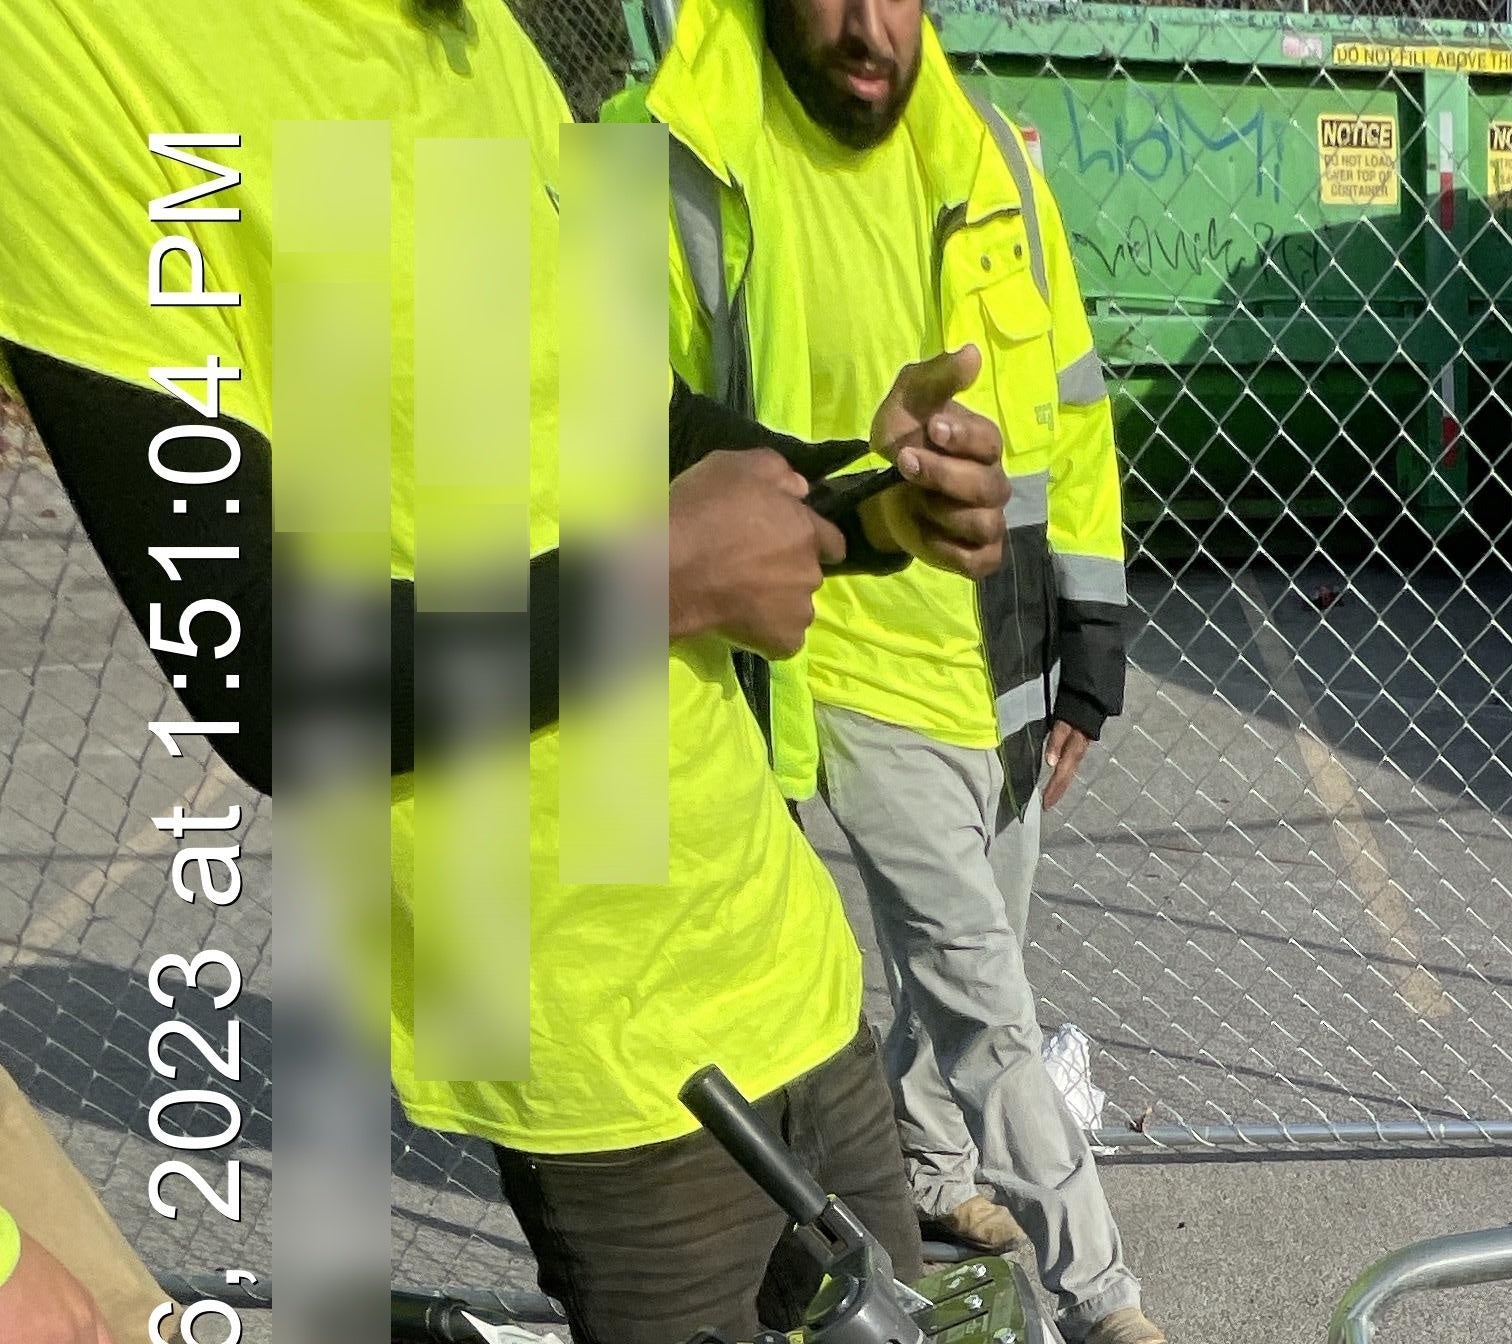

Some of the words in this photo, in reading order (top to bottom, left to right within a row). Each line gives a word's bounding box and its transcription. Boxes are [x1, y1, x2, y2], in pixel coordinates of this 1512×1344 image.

[1337, 48, 1358, 63] DO
[1436, 51, 1486, 69] ABOVE
[1323, 121, 1392, 147] NOTICE
